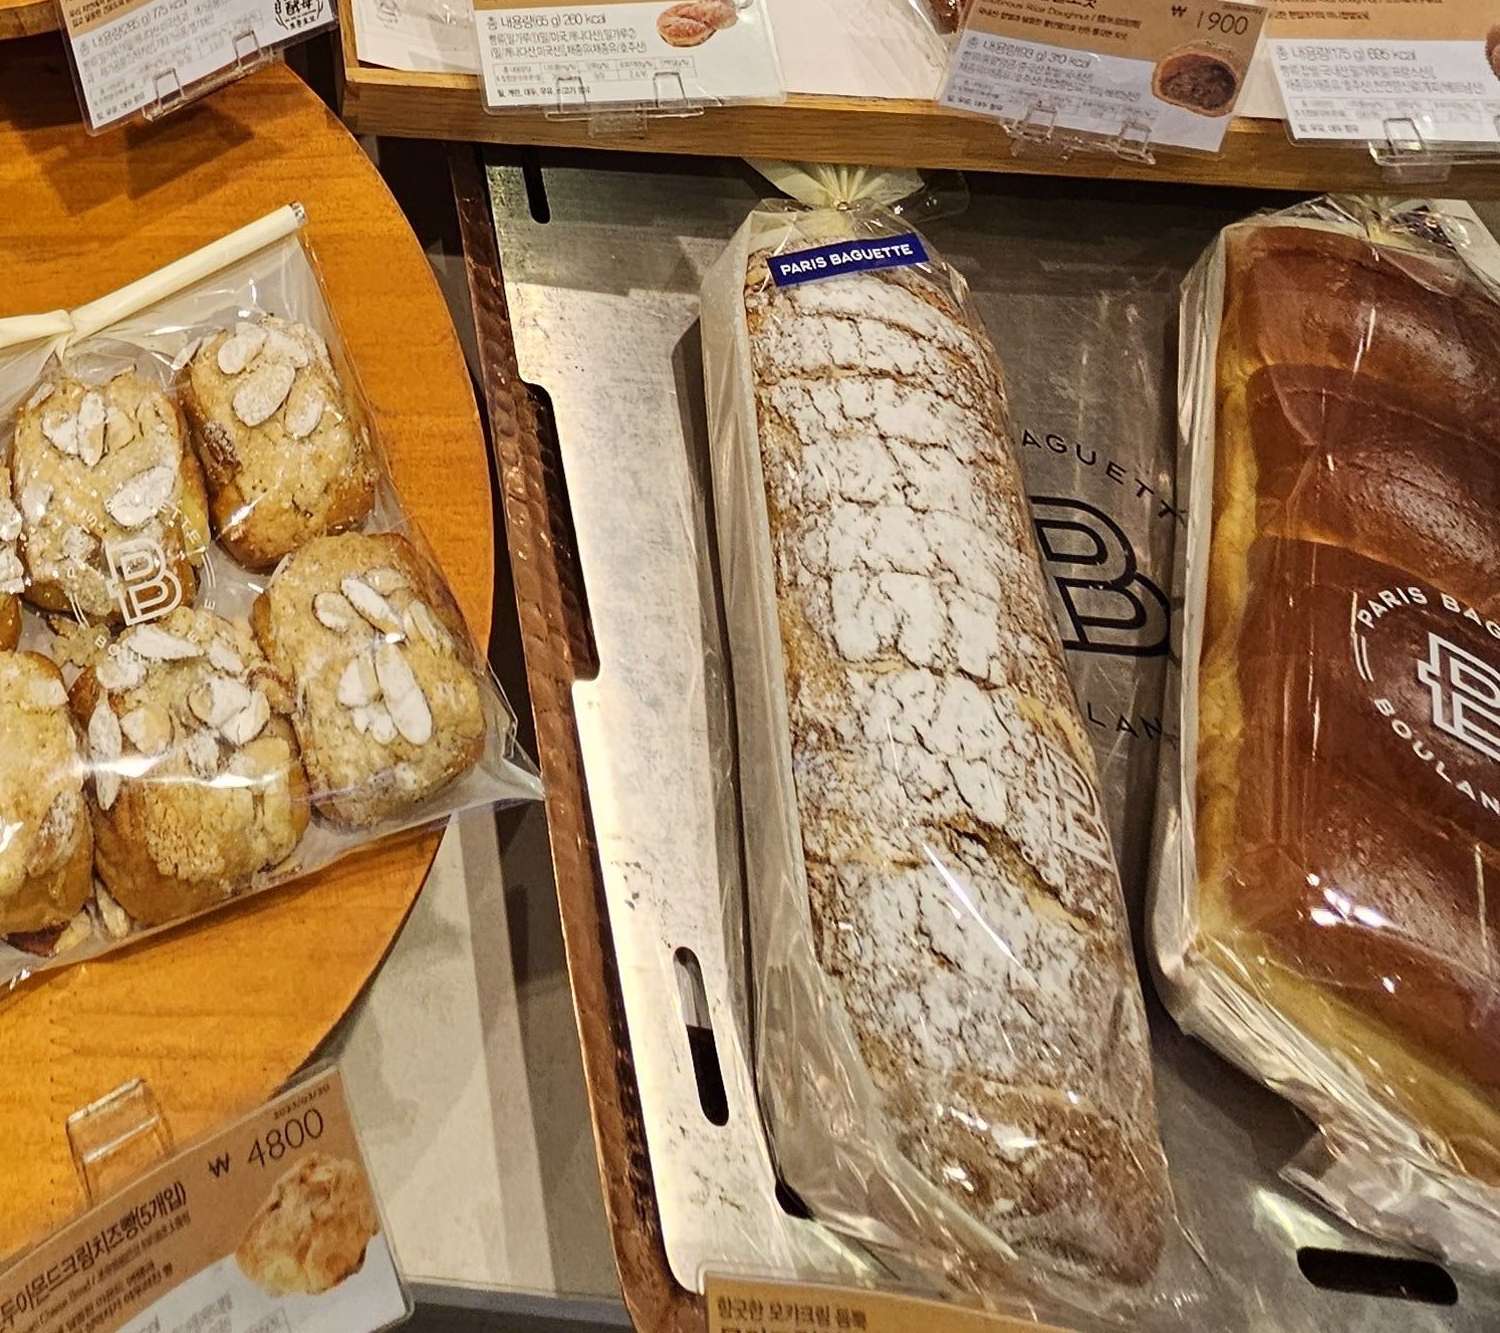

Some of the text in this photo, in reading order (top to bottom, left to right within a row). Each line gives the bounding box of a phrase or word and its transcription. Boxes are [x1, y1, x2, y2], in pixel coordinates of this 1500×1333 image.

[1196, 8, 1250, 36] 1900
[779, 244, 914, 277] PARIS BAGUETTE
[1356, 586, 1428, 630] PARIS
[247, 1107, 325, 1170] 4800
